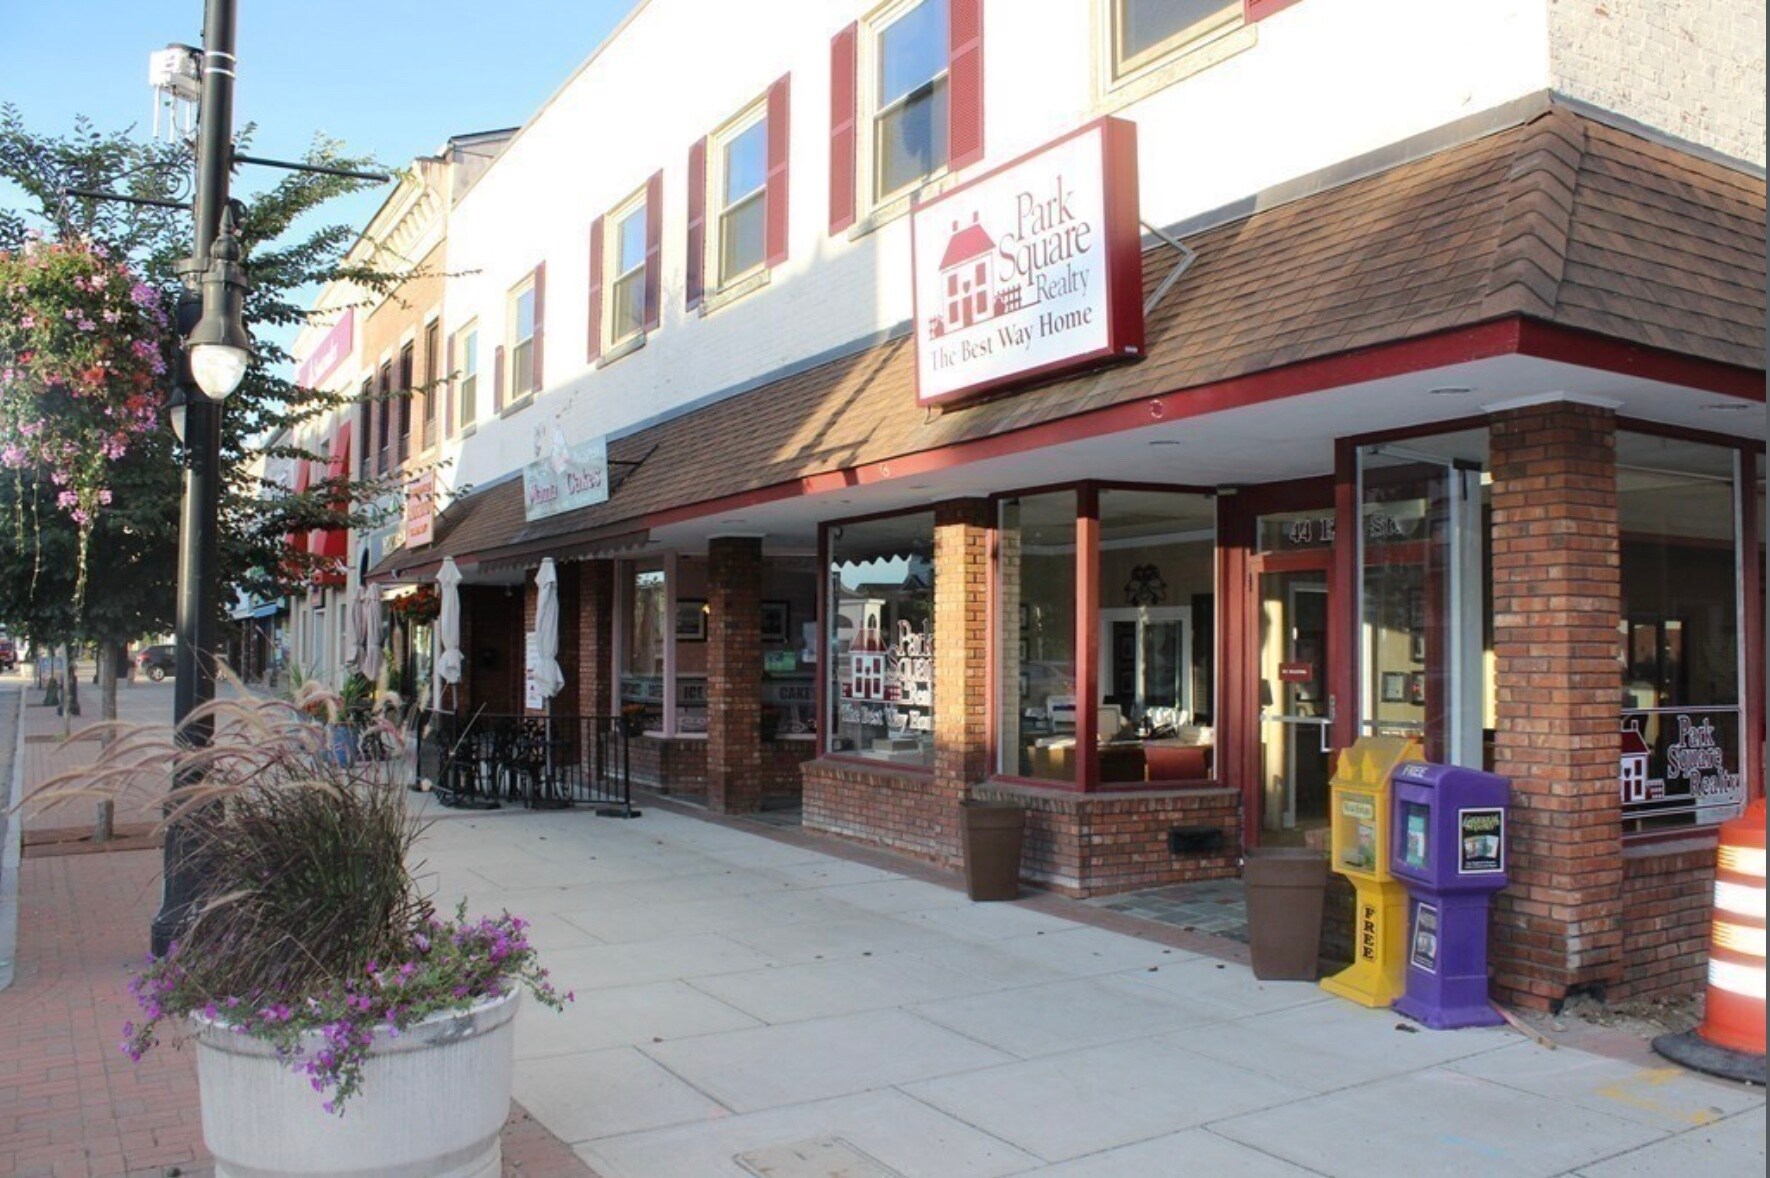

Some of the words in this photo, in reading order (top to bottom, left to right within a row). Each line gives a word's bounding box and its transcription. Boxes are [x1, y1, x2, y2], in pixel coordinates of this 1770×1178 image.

[1016, 173, 1076, 242] Park
[999, 221, 1091, 288] Square
[1036, 263, 1090, 303] Realty
[930, 346, 956, 371] The
[961, 338, 994, 361] Best
[997, 321, 1034, 351] Way
[1039, 305, 1093, 337] Home
[566, 468, 602, 496] Cakes
[1288, 519, 1313, 543] 44
[1676, 714, 1715, 747] Park
[1402, 764, 1429, 778] FREE
[1667, 744, 1723, 780] Square
[1361, 907, 1376, 961] FREE
